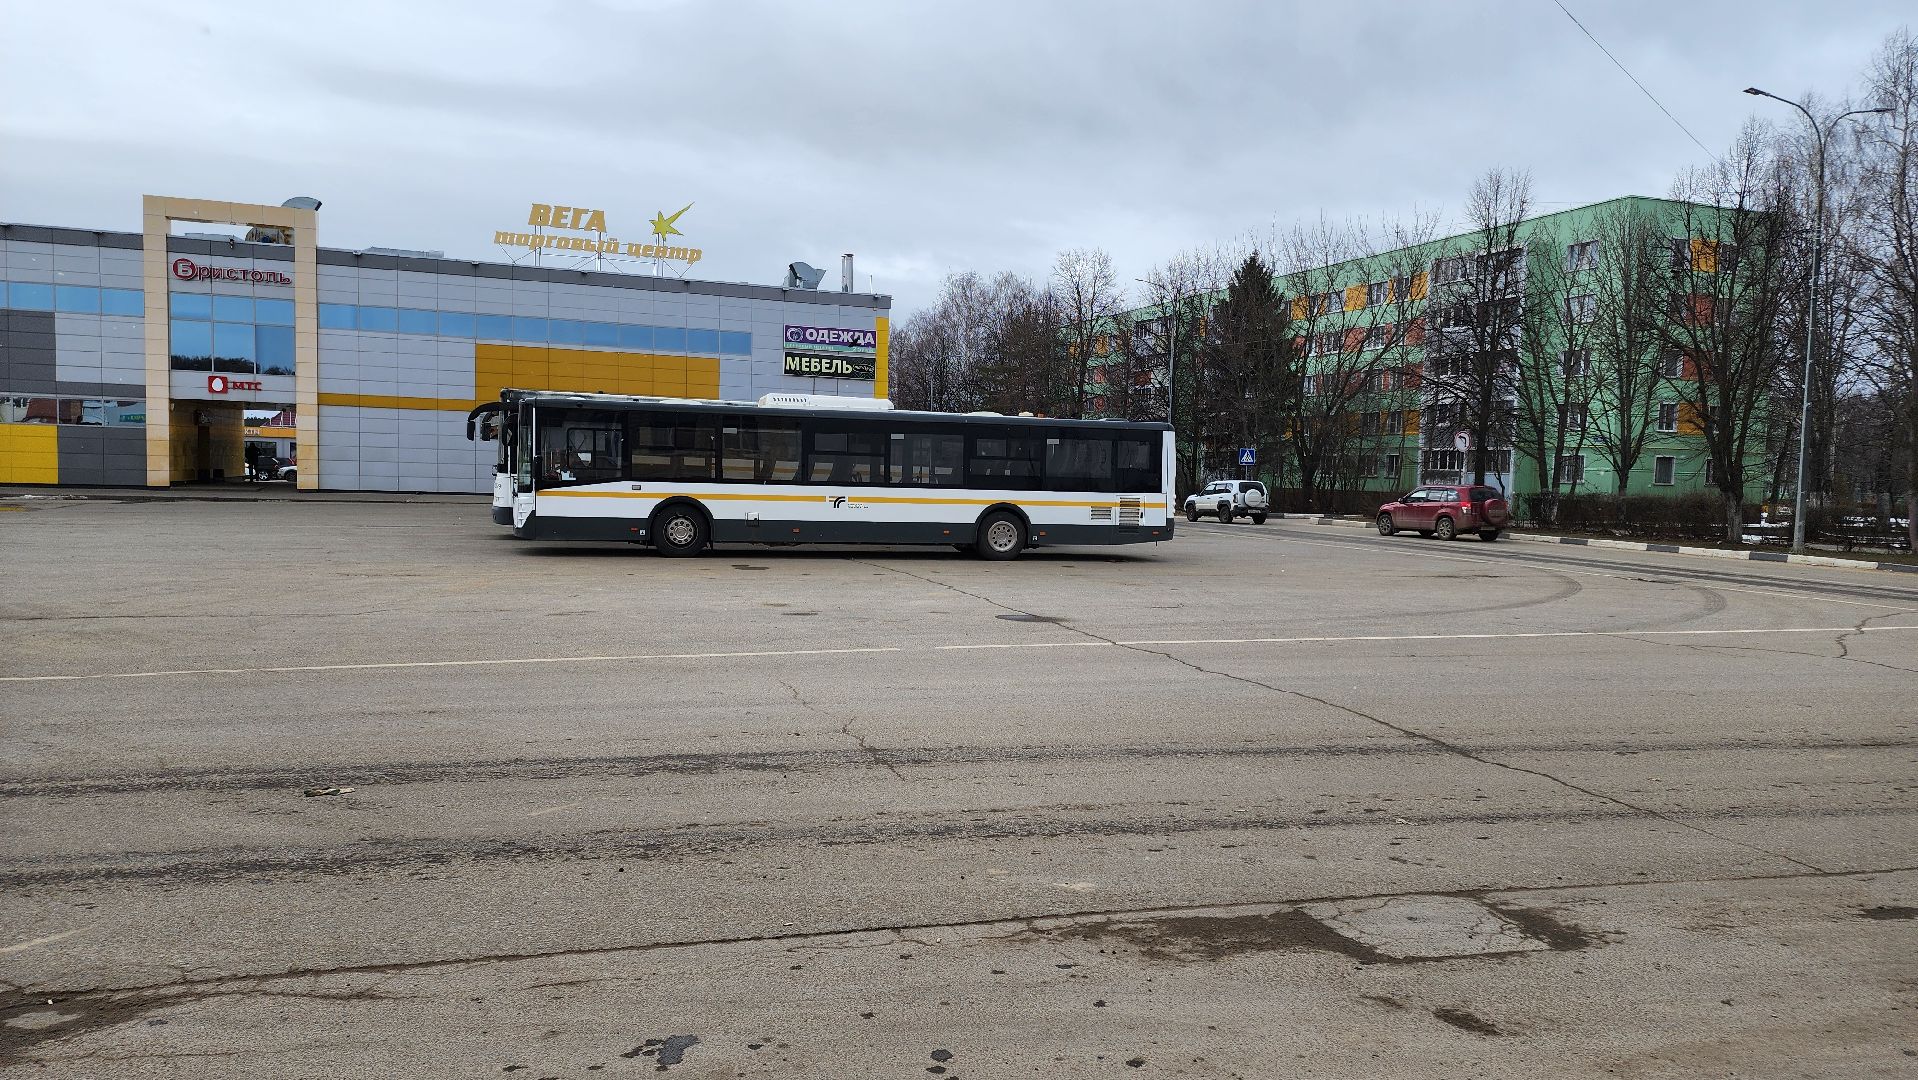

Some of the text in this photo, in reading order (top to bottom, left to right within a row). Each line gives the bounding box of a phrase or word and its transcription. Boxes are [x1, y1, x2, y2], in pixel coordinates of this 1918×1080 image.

[528, 203, 607, 233] ВЕГА
[626, 243, 703, 265] центр
[172, 258, 292, 285] Бристоль
[805, 328, 875, 345] ОДЕЖДА
[785, 356, 853, 374] МЕБЕЛЬ
